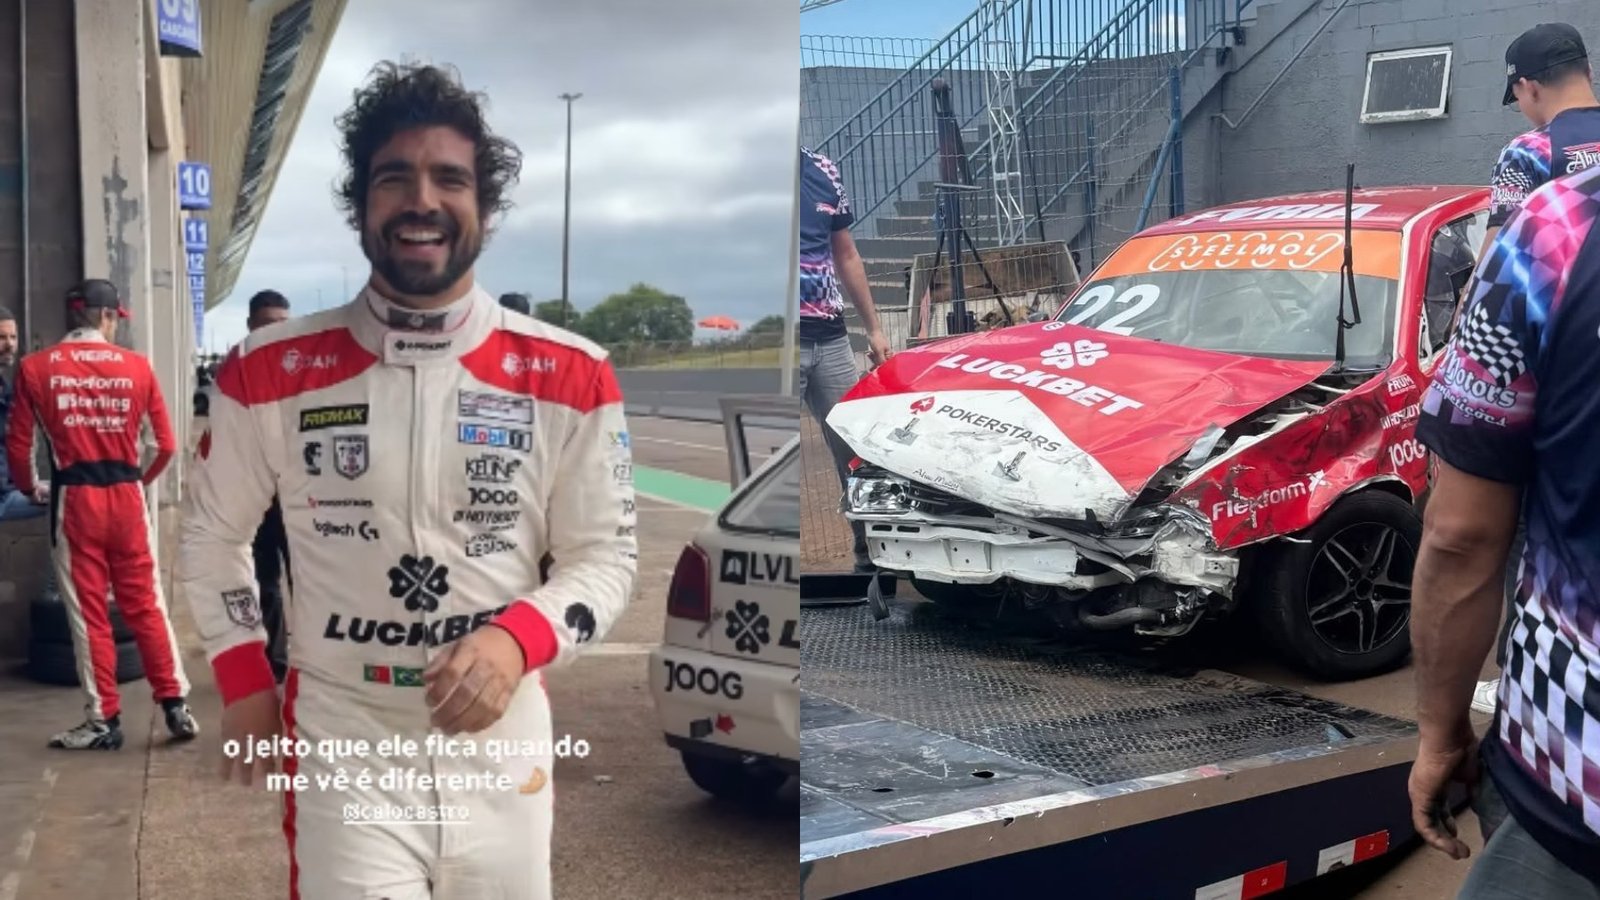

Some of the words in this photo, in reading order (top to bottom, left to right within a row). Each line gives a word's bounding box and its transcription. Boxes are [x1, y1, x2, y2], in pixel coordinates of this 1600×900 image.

[182, 167, 210, 196] 10
[188, 222, 208, 242] 11
[1170, 243, 1319, 258] STEELMOL
[1066, 283, 1161, 336] 22
[938, 353, 1145, 416] LUCKBET
[936, 404, 1061, 453] POKERSTARS
[323, 604, 510, 648] LUCKBE
[664, 659, 744, 700] JOOG
